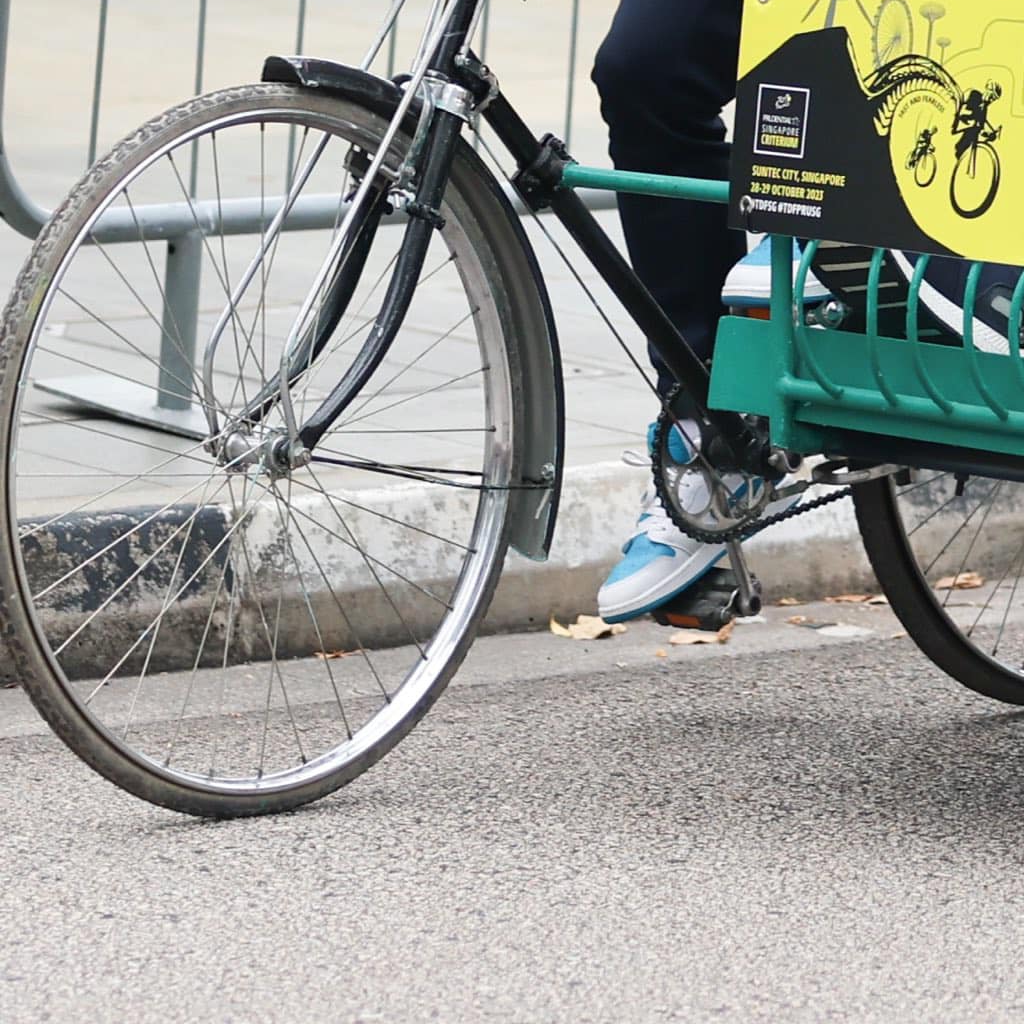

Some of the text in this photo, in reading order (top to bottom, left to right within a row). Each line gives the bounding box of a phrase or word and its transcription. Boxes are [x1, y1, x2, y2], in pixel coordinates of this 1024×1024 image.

[761, 124, 800, 136] SINGAPORE
[760, 134, 799, 148] CRITERIUM
[752, 165, 846, 187] SUNTEC CITY, SINGAPORE
[750, 181, 824, 201] 28-29 OCTOBER 2023
[778, 201, 822, 218] #TDFPRUSG
